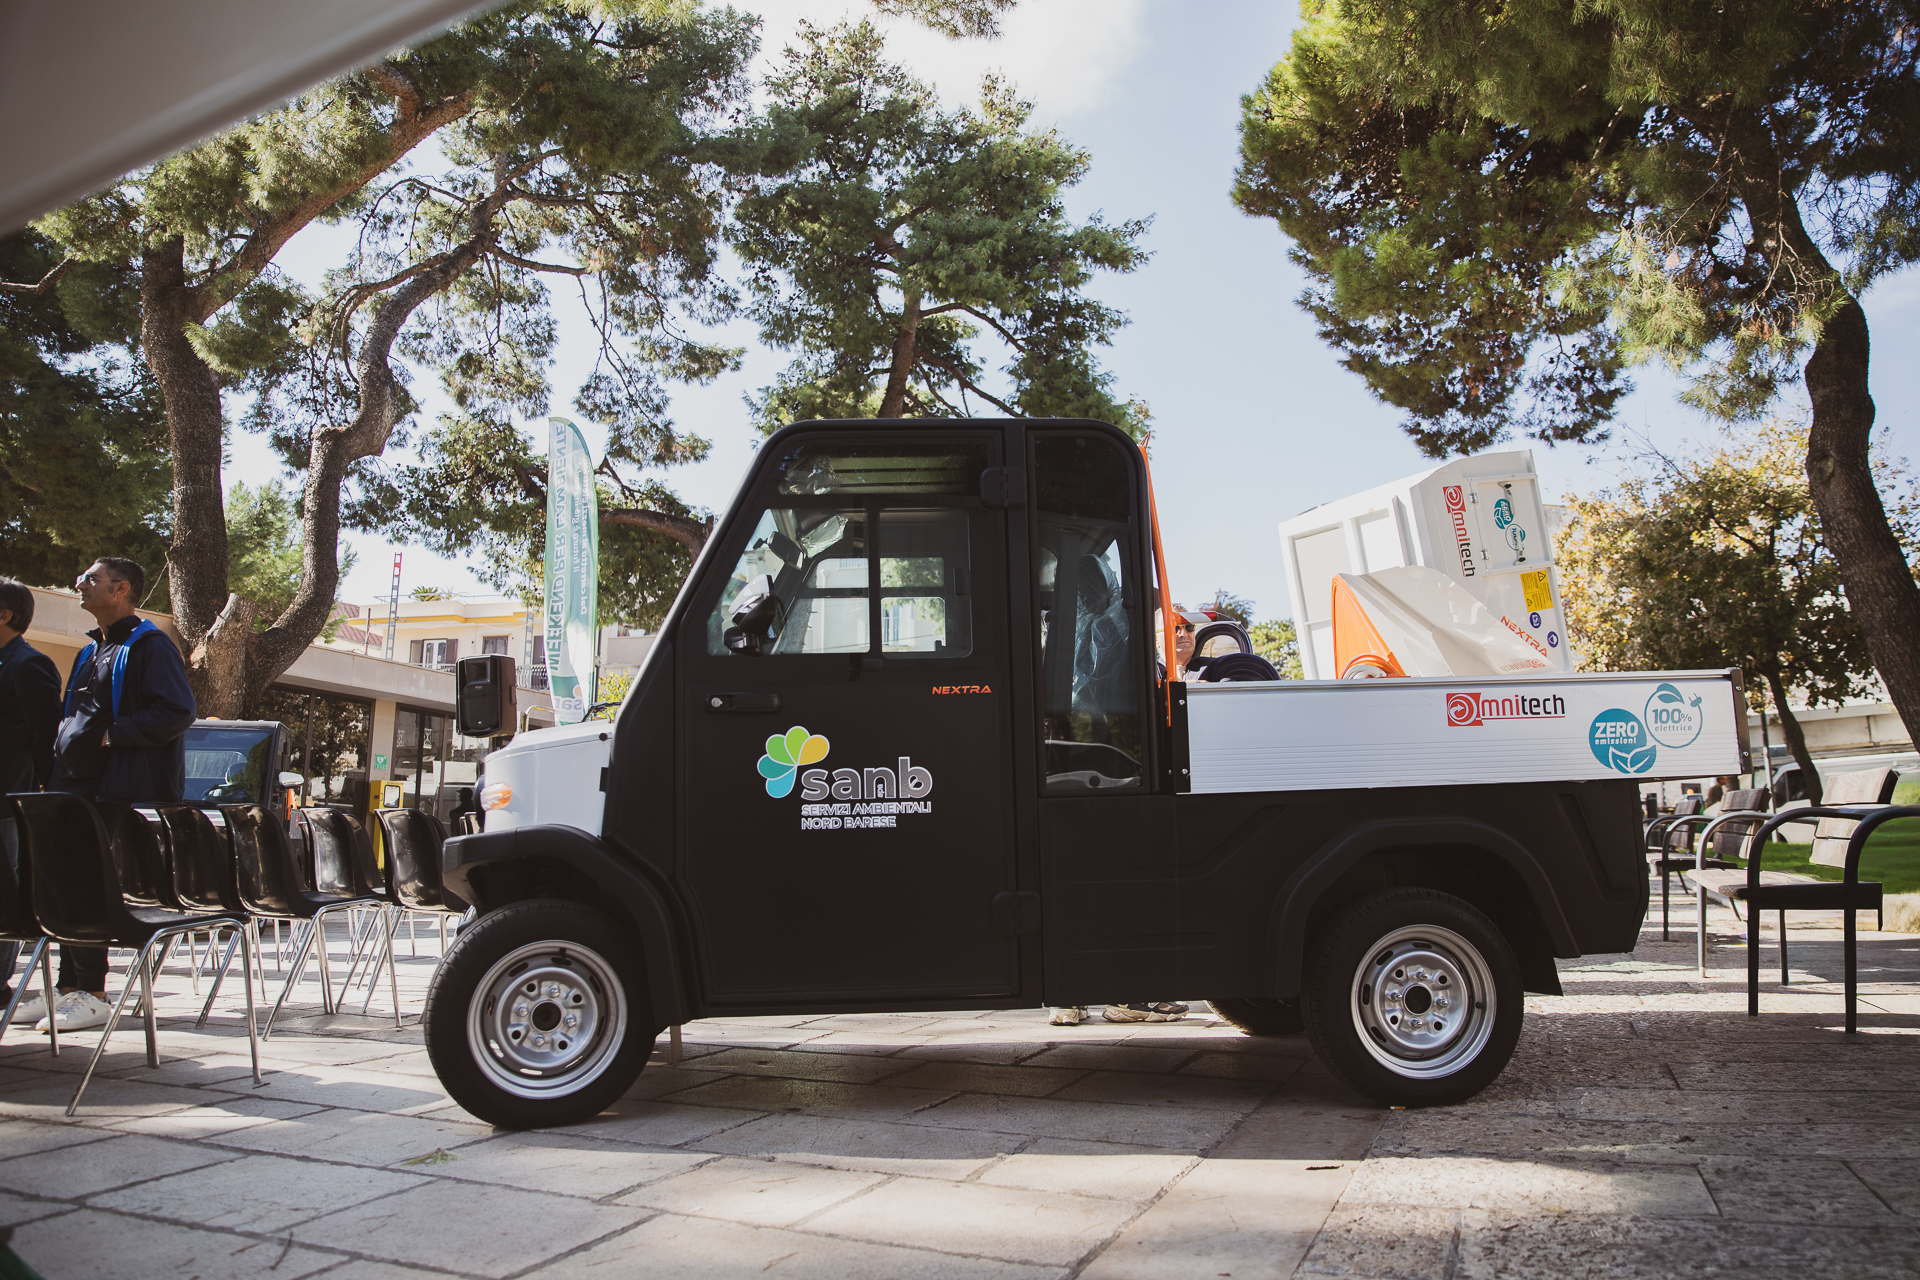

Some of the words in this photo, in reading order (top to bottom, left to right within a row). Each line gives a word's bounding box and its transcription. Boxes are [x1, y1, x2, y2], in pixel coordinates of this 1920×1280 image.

[1500, 615, 1548, 658] NEXTRA
[932, 685, 992, 694] NEXTRA
[1652, 708, 1692, 725] 100%
[1594, 721, 1639, 738] ZERO
[1655, 724, 1692, 732] elettrico
[1595, 737, 1637, 745] emissioni
[801, 756, 933, 801] sanb
[801, 803, 851, 816] SERVIZI
[852, 801, 932, 815] AMBIENTALI
[801, 817, 842, 830] NORD
[844, 816, 897, 829] BARESE
